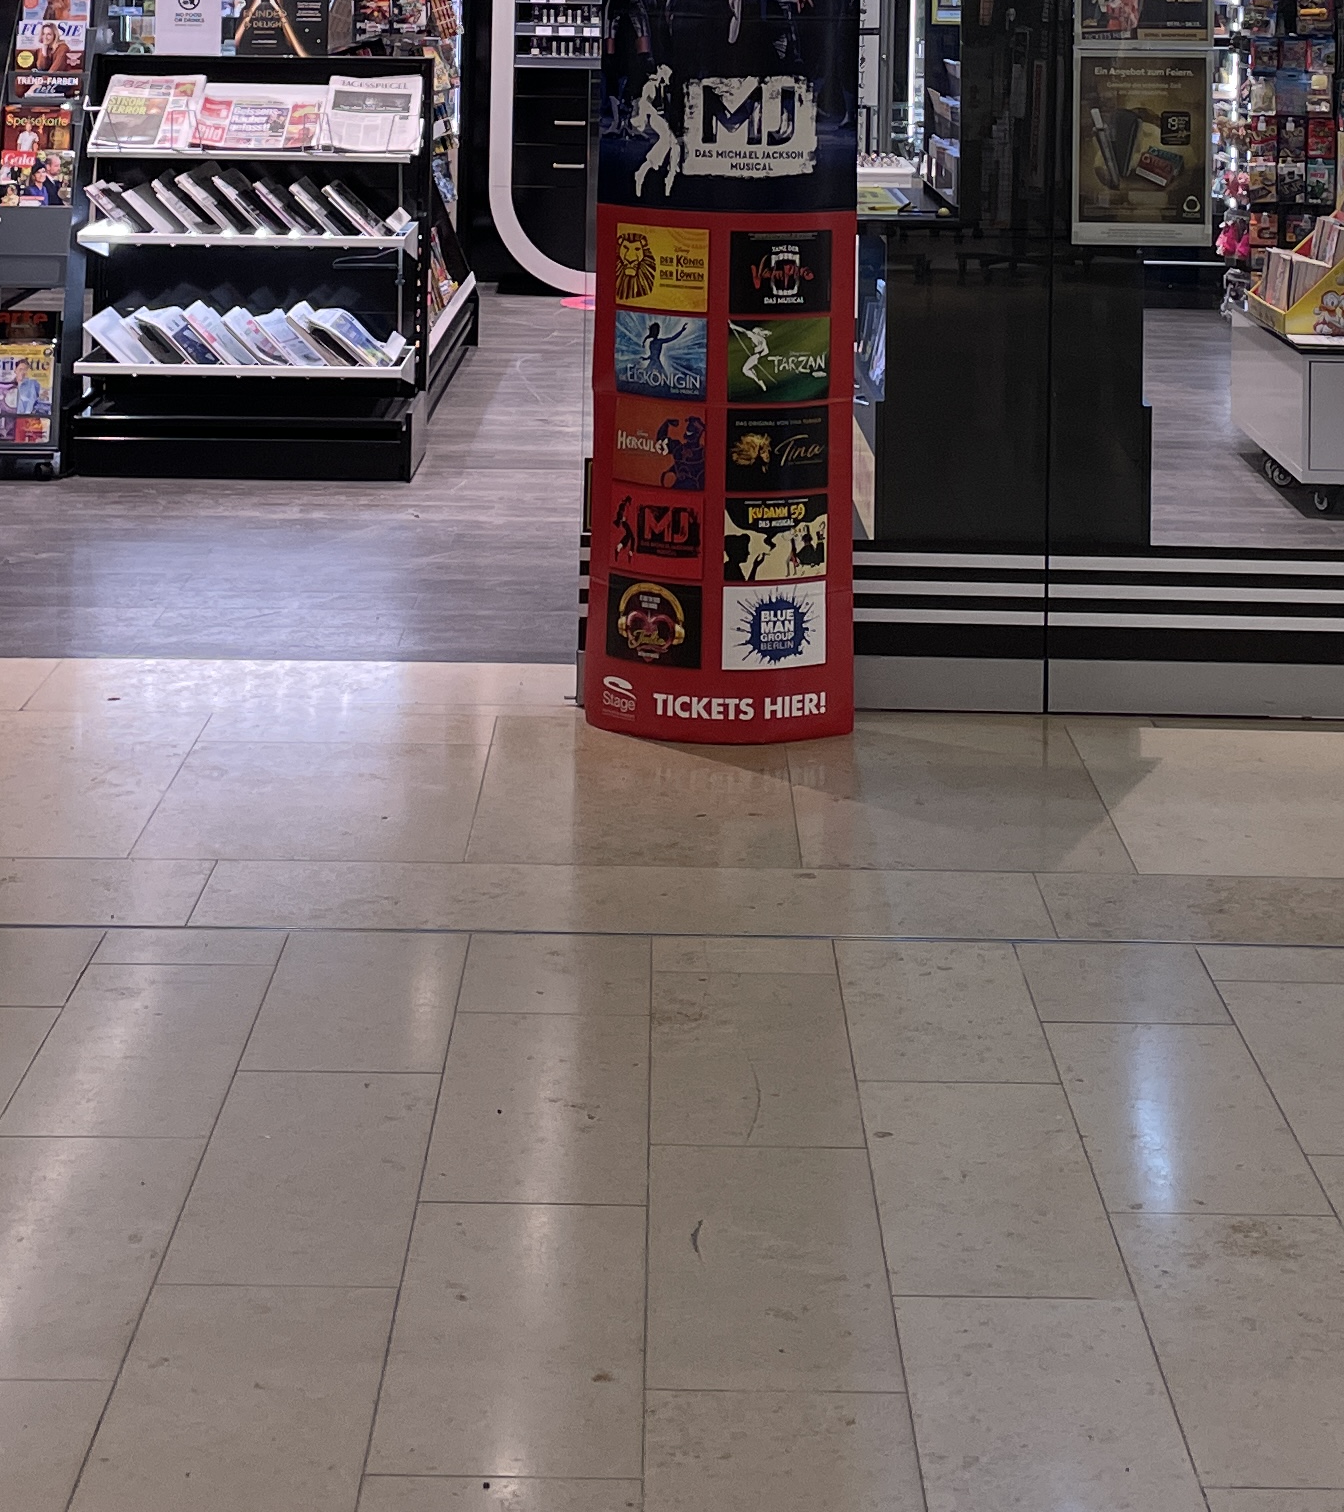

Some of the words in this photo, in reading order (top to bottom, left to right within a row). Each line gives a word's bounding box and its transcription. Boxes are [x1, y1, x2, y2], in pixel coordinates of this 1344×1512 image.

[1094, 66, 1108, 76] Ein
[1109, 67, 1145, 77] Angebot
[1147, 68, 1164, 76] zum
[1166, 68, 1195, 77] Feiern.
[6, 113, 69, 129] Speisekarte
[701, 85, 796, 147] MJ
[3, 152, 36, 167] Gala
[695, 149, 714, 159] DAS
[716, 150, 759, 160] MICHAEL
[760, 150, 804, 160] JACKSON
[730, 162, 774, 172] MUSICAL
[659, 255, 674, 267] DER
[675, 254, 705, 268] KÖNIG
[659, 269, 674, 280] DER
[675, 268, 705, 282] LÖWEN
[767, 353, 826, 374] TARZAN
[617, 429, 669, 456] HERCULES
[790, 503, 806, 519] 59
[760, 608, 795, 622] BLUE
[760, 620, 794, 633] MAN
[760, 631, 794, 642] GROUP
[760, 640, 794, 651] BERLIN
[602, 690, 636, 713] Stage
[652, 692, 755, 721] TICKETS
[763, 691, 827, 720] HIER!
